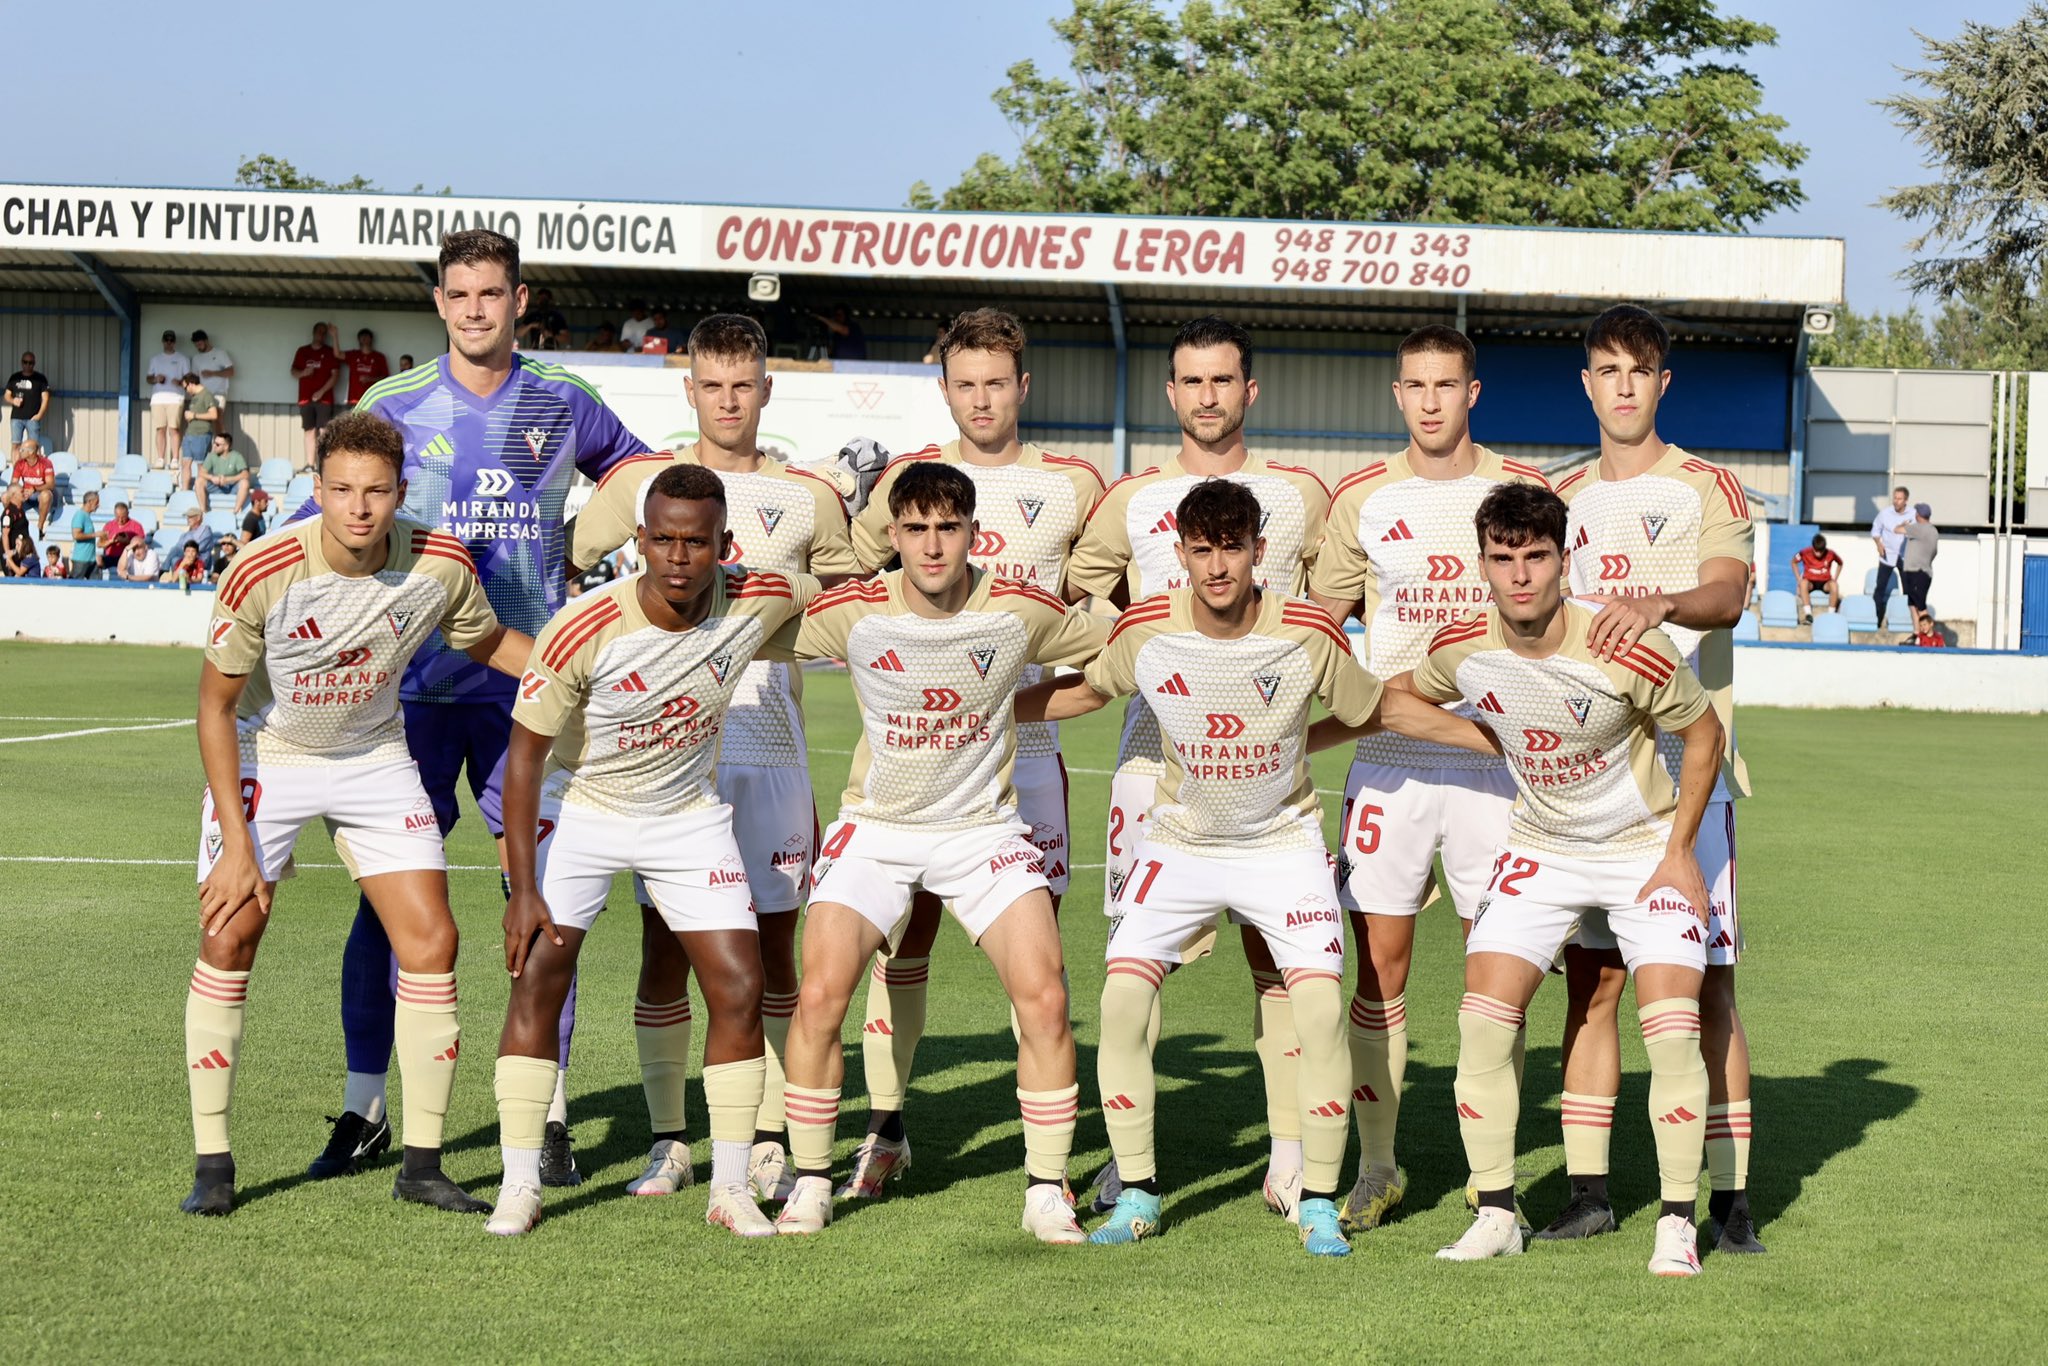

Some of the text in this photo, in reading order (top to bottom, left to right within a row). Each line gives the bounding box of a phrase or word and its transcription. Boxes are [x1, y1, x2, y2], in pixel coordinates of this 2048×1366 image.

[3, 196, 677, 254] CHAPA Y PINTURA MARIANO MÓGICA
[716, 215, 1246, 276] CONSTRUCCIONES LERGA
[1275, 227, 1471, 258] 948 701 343
[1271, 257, 1471, 288] 948 700 840
[442, 500, 540, 519] MIRANDA
[442, 521, 540, 540] EMPRESAS
[1395, 587, 1496, 603] MIRANDA
[1397, 607, 1470, 623] EMPRE
[292, 688, 374, 706] EMPRES
[886, 726, 990, 750] EMPRESAS
[1186, 758, 1280, 780] MPRESAS
[404, 813, 437, 830] Aluc
[1342, 797, 1384, 855] 15
[822, 822, 857, 859] 4
[989, 849, 1039, 874] Alucoil
[1487, 851, 1540, 897] 12
[1286, 908, 1339, 928] Alucoil
